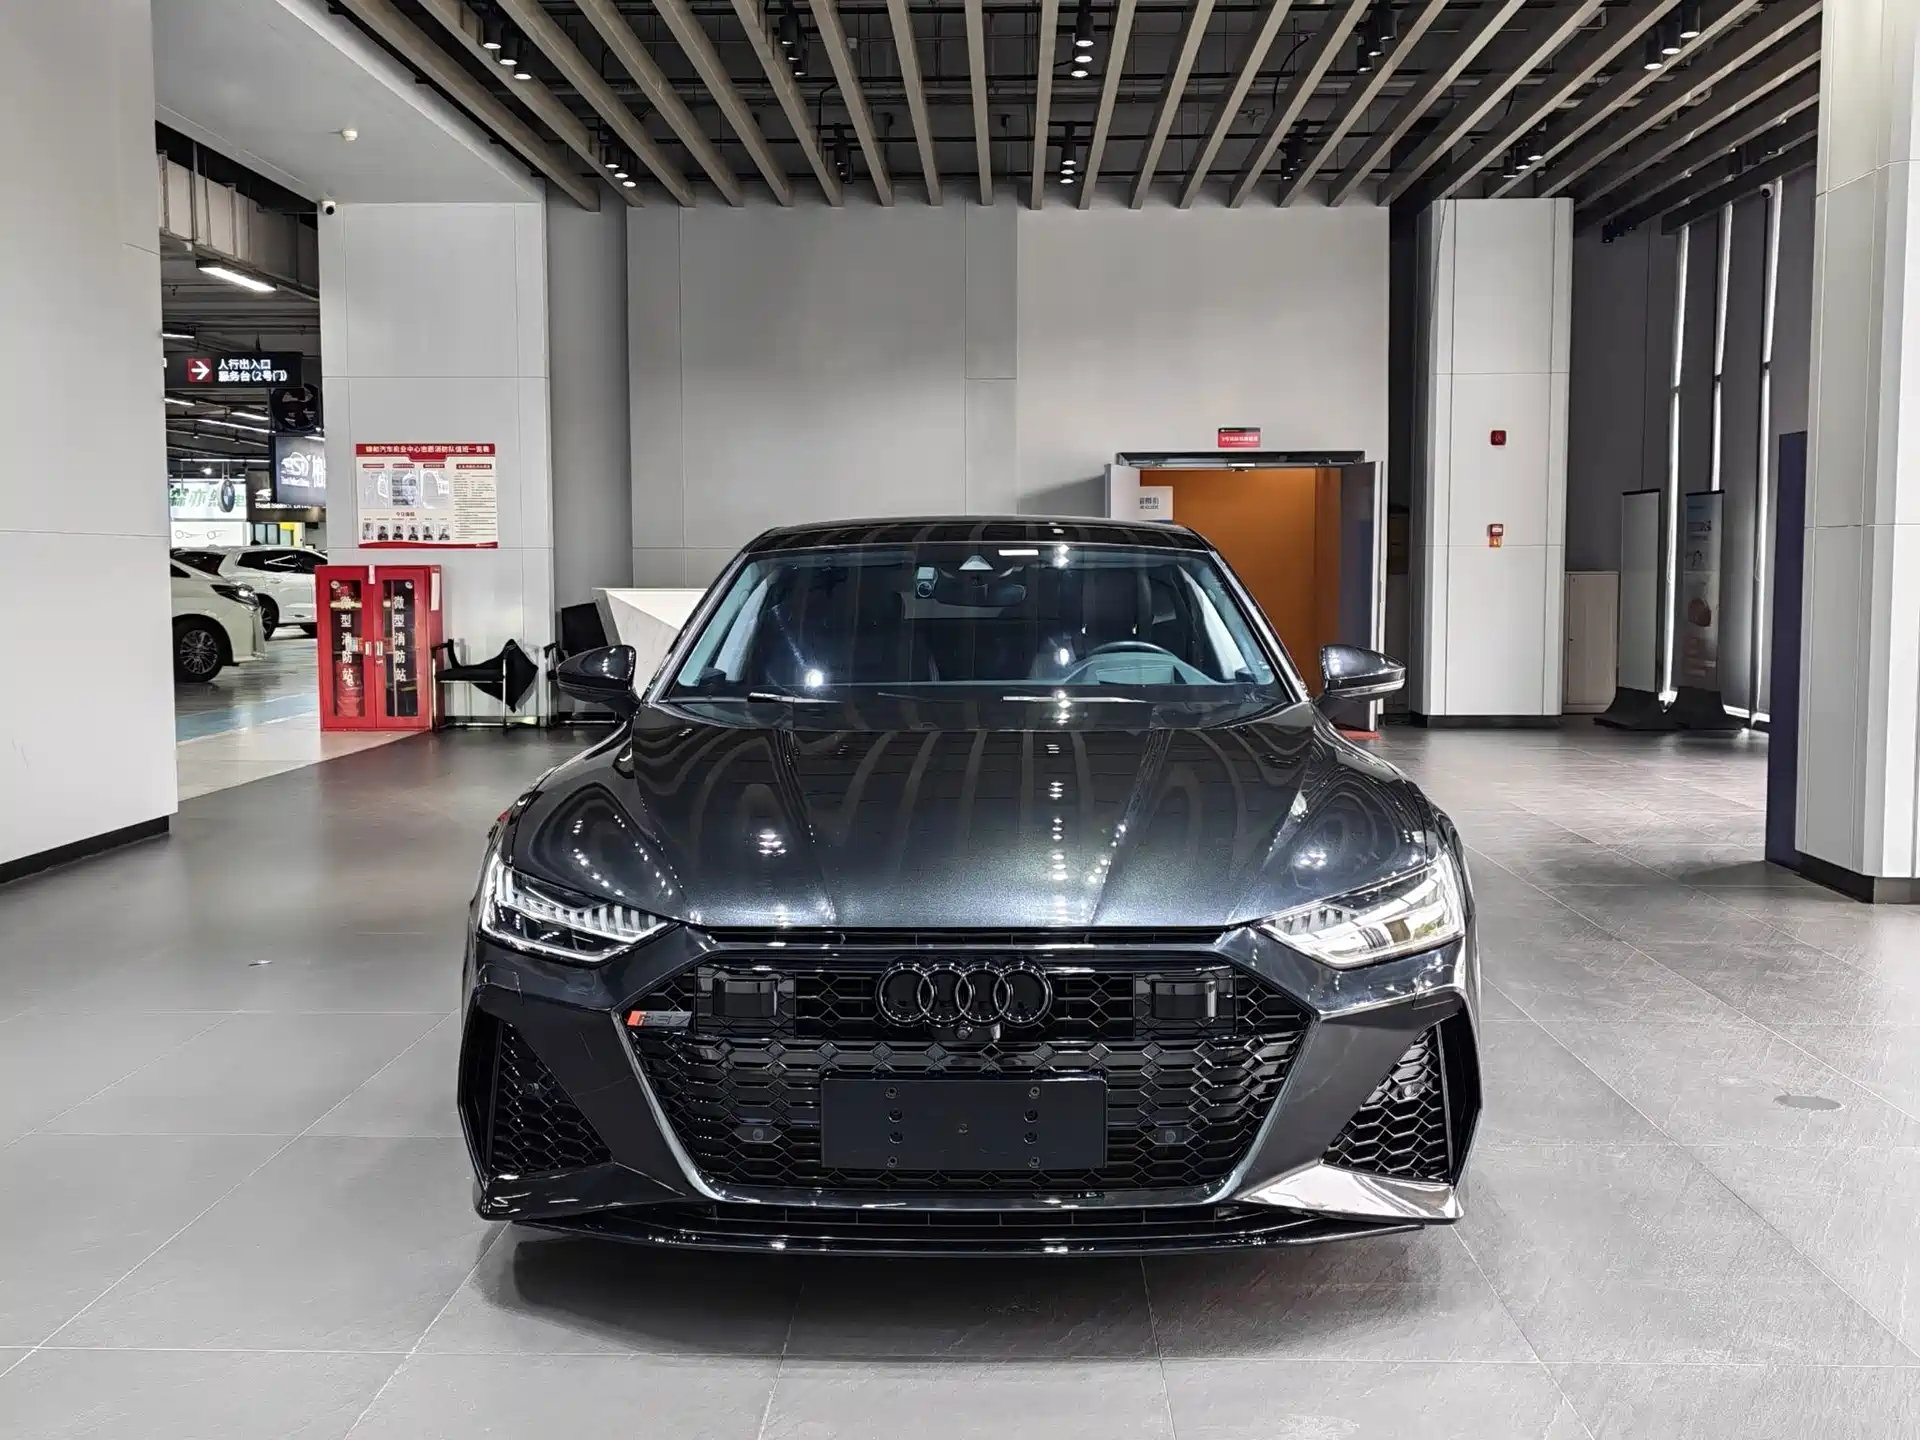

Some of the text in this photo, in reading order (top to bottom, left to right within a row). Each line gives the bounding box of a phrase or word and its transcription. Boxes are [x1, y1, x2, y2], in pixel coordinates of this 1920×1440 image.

[218, 358, 271, 370] 人行出入口
[218, 370, 287, 382] 服务台(2号门)
[340, 596, 354, 682] 微型消防站
[393, 596, 407, 682] 微型消防站
